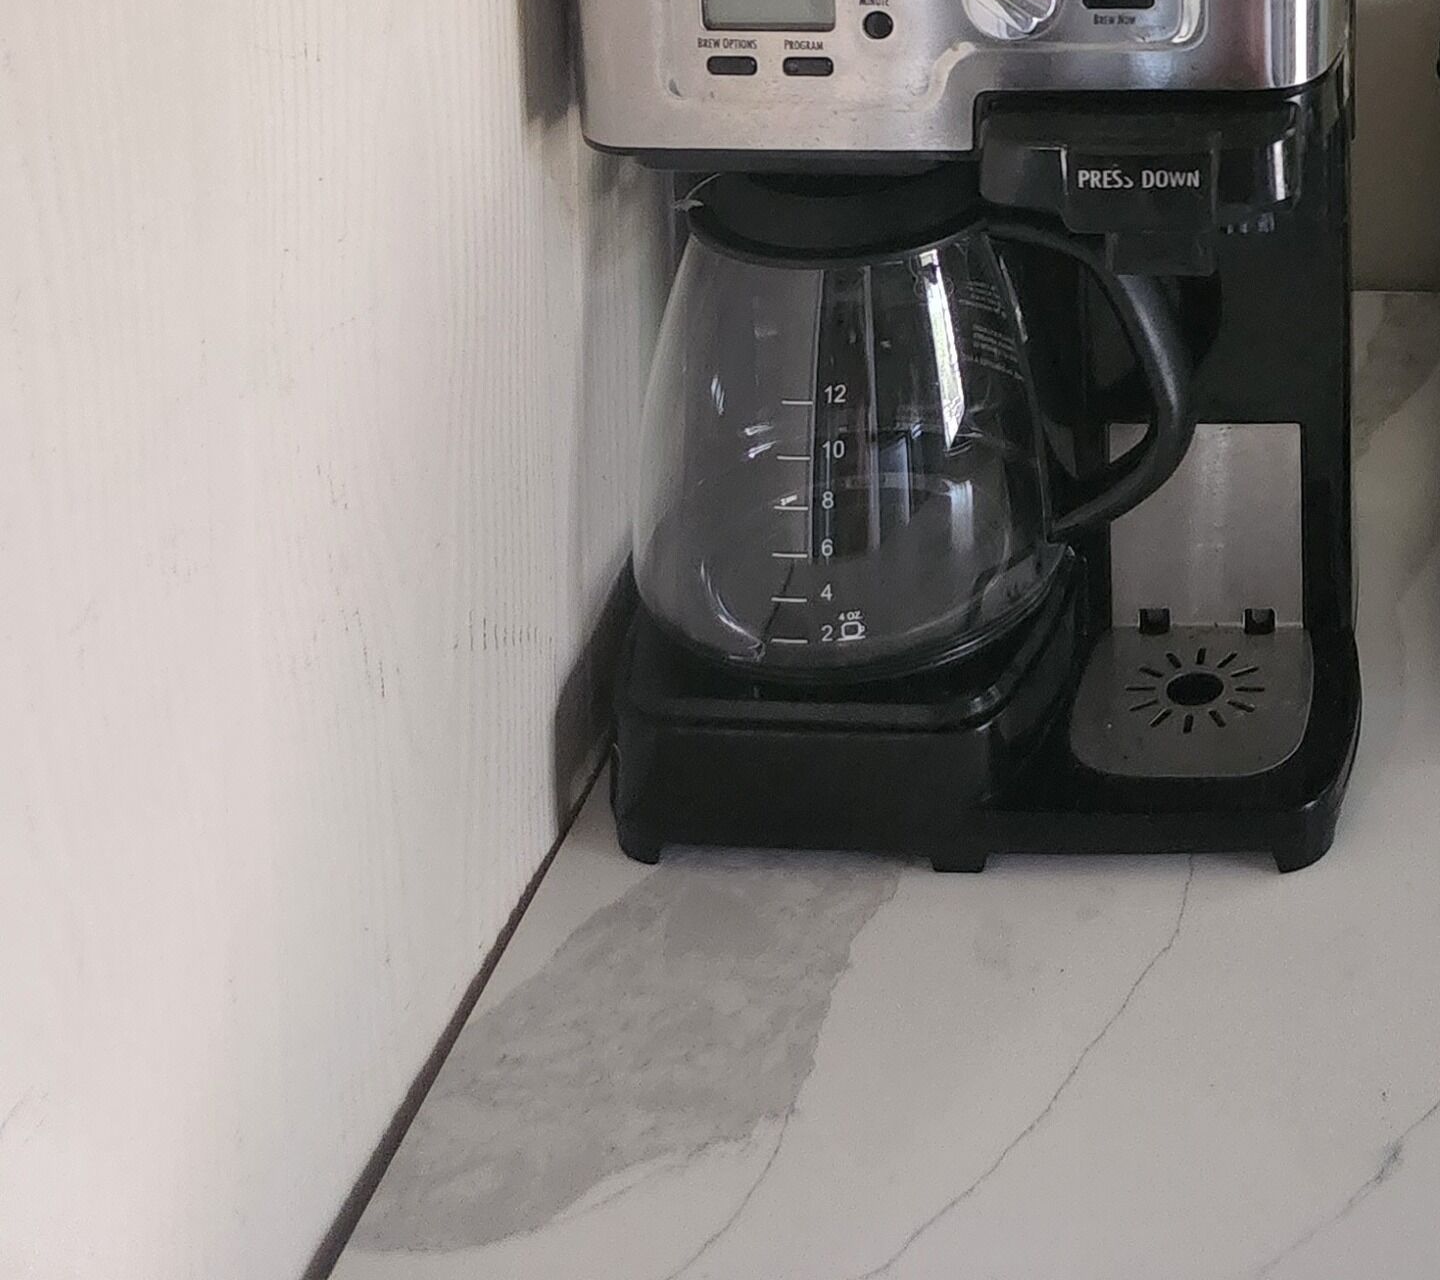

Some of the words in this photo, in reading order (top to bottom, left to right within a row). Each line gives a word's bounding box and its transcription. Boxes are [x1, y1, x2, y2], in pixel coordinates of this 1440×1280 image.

[784, 40, 824, 51] PROGRAM
[1142, 169, 1200, 189] DOWN
[824, 384, 847, 404] 12
[822, 440, 845, 458] 10
[821, 490, 834, 509] 8
[821, 538, 833, 557] 6
[820, 583, 833, 601] 4
[820, 624, 833, 642] 2
